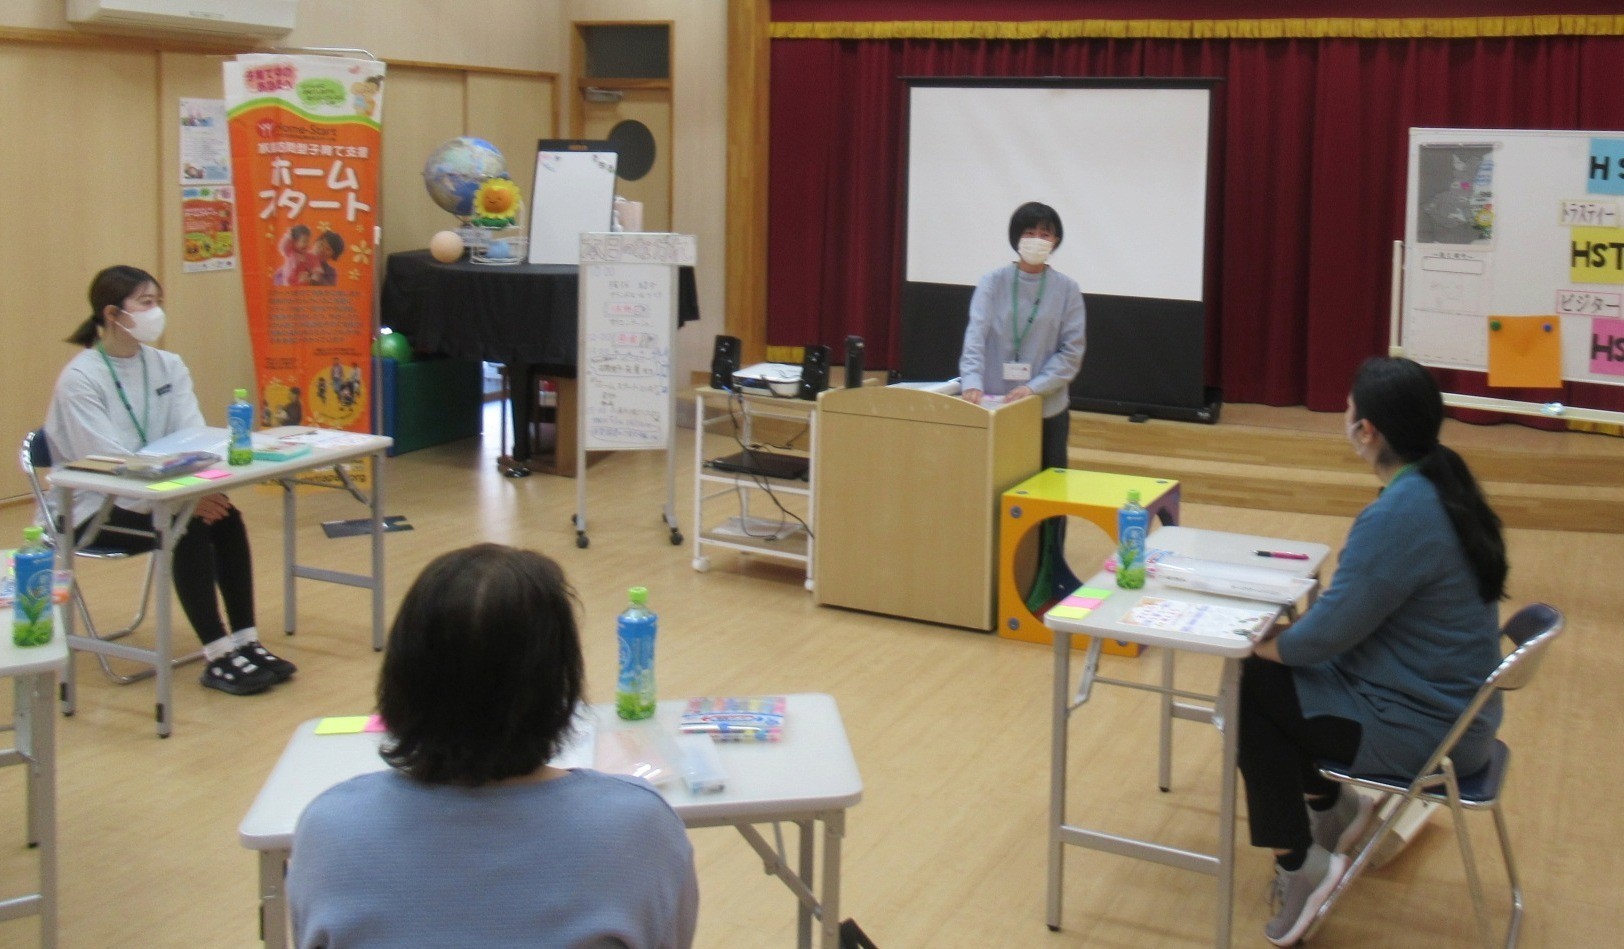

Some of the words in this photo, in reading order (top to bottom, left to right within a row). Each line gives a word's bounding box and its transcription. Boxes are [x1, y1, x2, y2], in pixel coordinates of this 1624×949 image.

[271, 156, 360, 190] ホーム
[259, 188, 371, 222] スタート
[1561, 202, 1615, 225] トラスティー
[1560, 293, 1620, 313] ビジター
